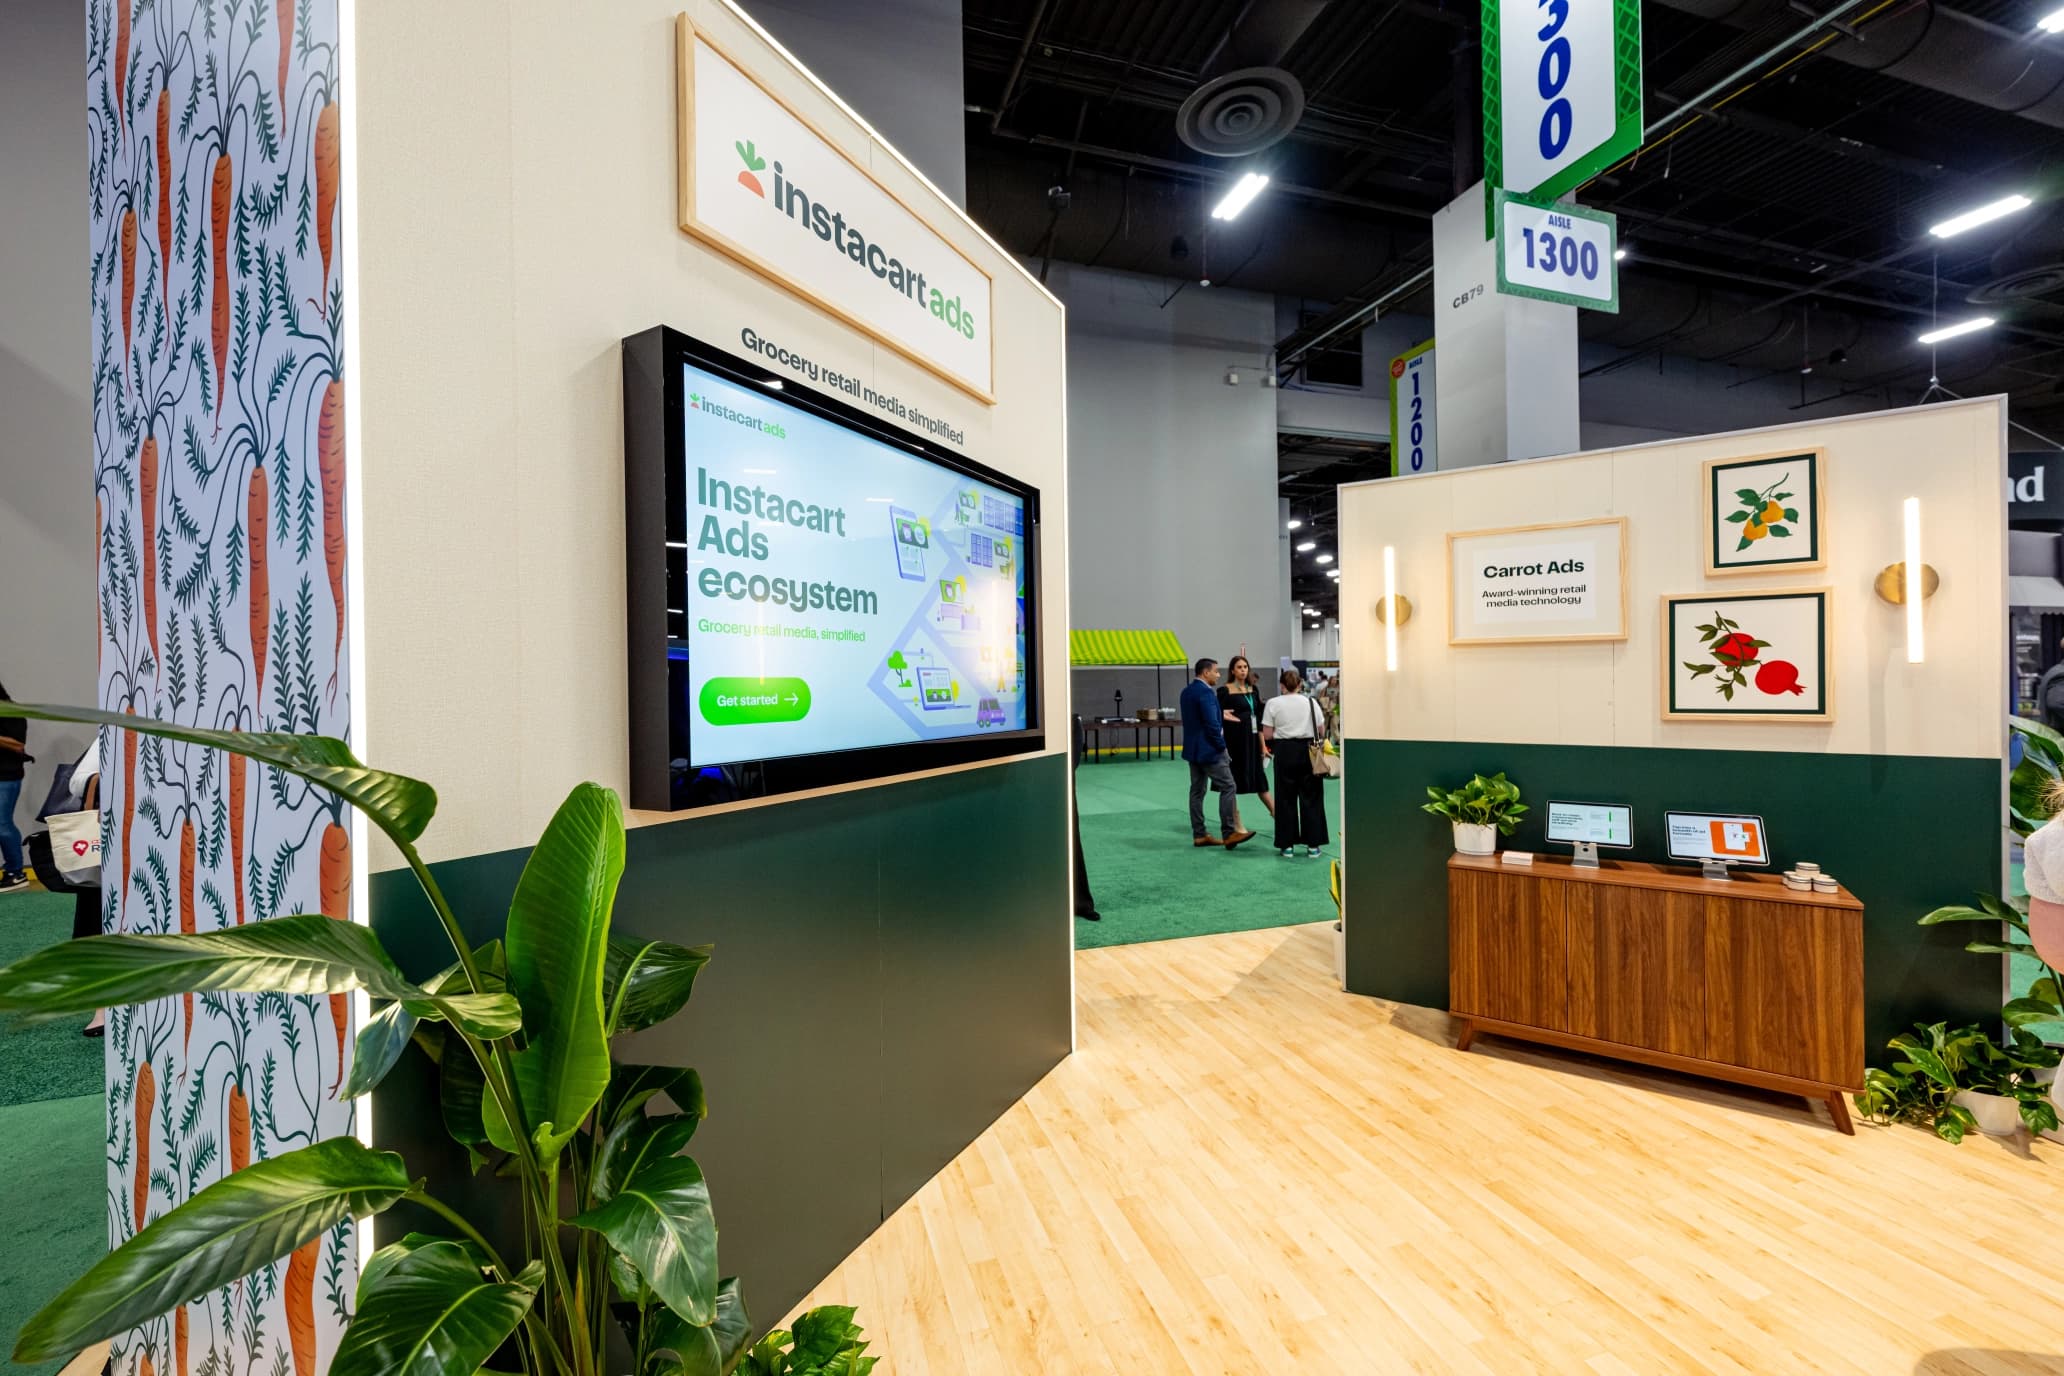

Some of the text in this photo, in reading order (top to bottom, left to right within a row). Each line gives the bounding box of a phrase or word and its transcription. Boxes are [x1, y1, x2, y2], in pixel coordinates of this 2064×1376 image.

[1548, 213, 1572, 230] AISLE
[1522, 227, 1599, 281] 1300
[1452, 284, 1485, 310] CB79
[741, 327, 963, 446] Grocery retail media simplified
[1411, 371, 1423, 471] 1200
[697, 466, 846, 537] Instacart
[697, 514, 769, 561] Ads
[1484, 559, 1585, 579] Carrot Ads
[697, 566, 878, 616] ecosystem
[1482, 584, 1587, 598] Award-winning retail
[1486, 596, 1582, 608] media technology
[697, 618, 866, 643] Grocery retail media, simplified
[716, 692, 779, 707] Get started
